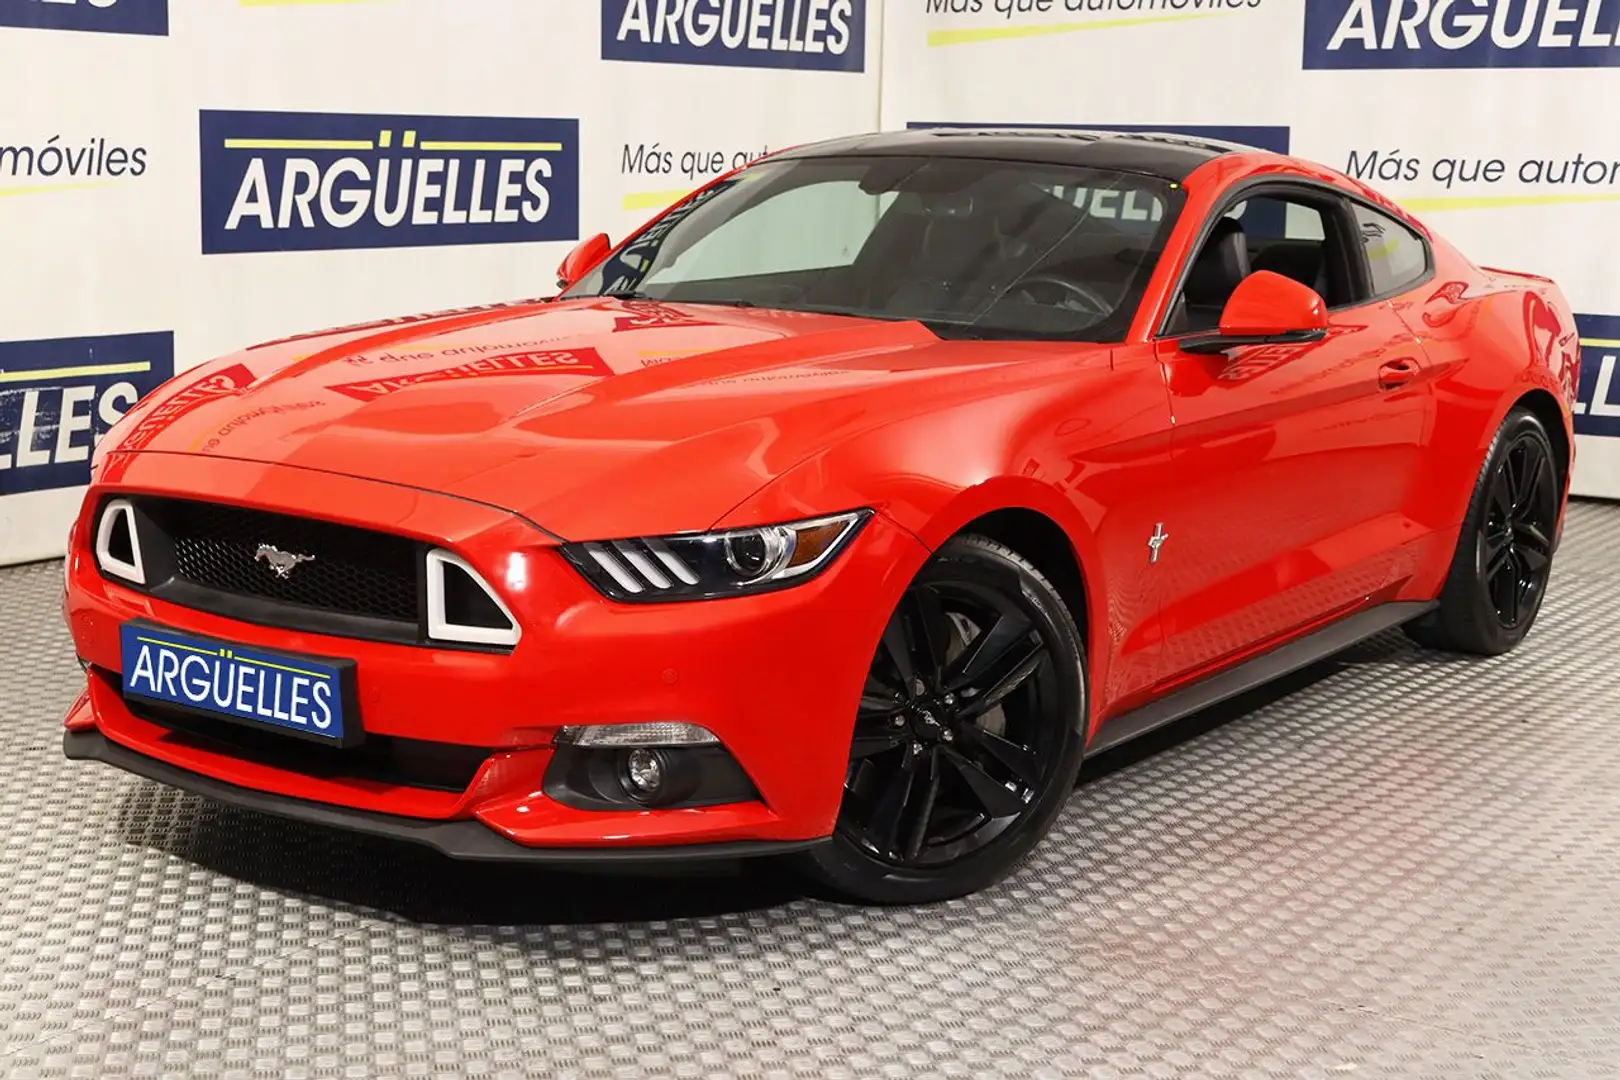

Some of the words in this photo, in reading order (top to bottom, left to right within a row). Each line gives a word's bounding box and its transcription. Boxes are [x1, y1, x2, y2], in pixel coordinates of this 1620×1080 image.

[0, 134, 147, 177] móviles
[224, 130, 552, 230] ARGÜELLES
[621, 142, 673, 174] Más
[680, 150, 724, 180] que
[1346, 149, 1420, 181] Más
[1432, 158, 1505, 189] que
[0, 381, 138, 470] LES
[129, 645, 332, 729] ARGÜELLES
